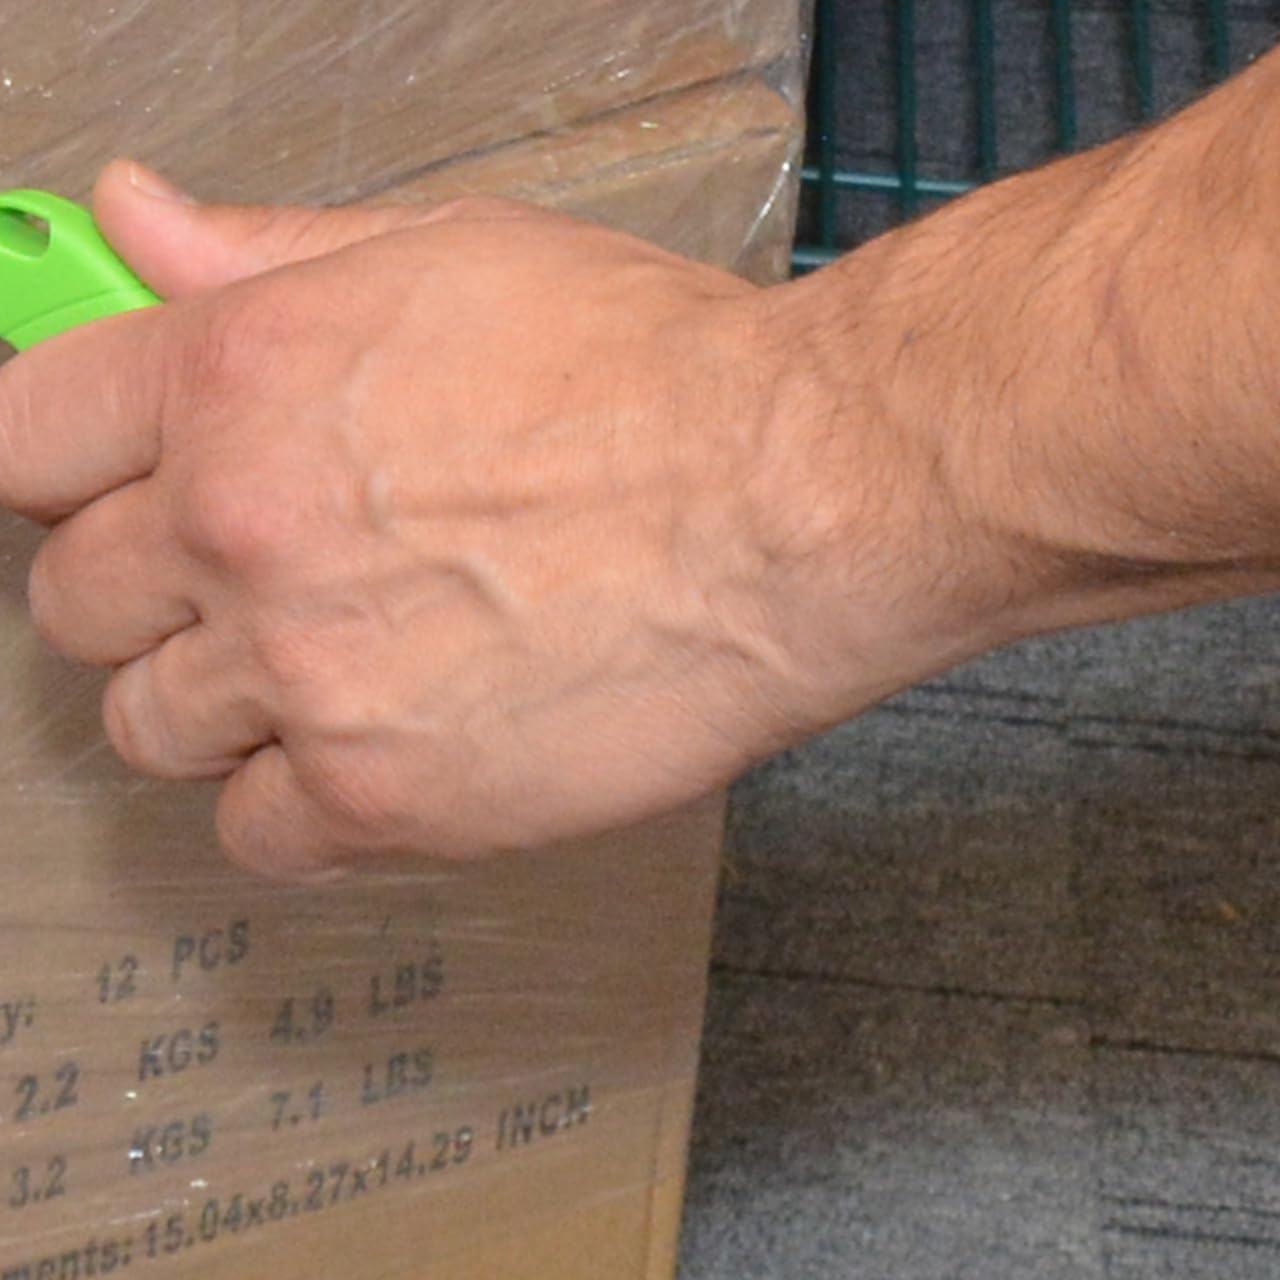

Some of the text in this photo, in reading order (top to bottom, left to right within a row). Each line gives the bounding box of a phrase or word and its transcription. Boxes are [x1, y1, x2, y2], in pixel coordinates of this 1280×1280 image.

[95, 954, 139, 1004] 12
[171, 920, 251, 983] PCS
[15, 1061, 81, 1122] 2.2
[138, 1021, 219, 1081] KGS
[368, 956, 445, 1017] LBS
[8, 1154, 68, 1210] 3.2
[129, 1113, 213, 1175] KGS
[270, 1081, 323, 1131] 7.1
[361, 1048, 434, 1107] LBS
[496, 1084, 591, 1151] INCH
